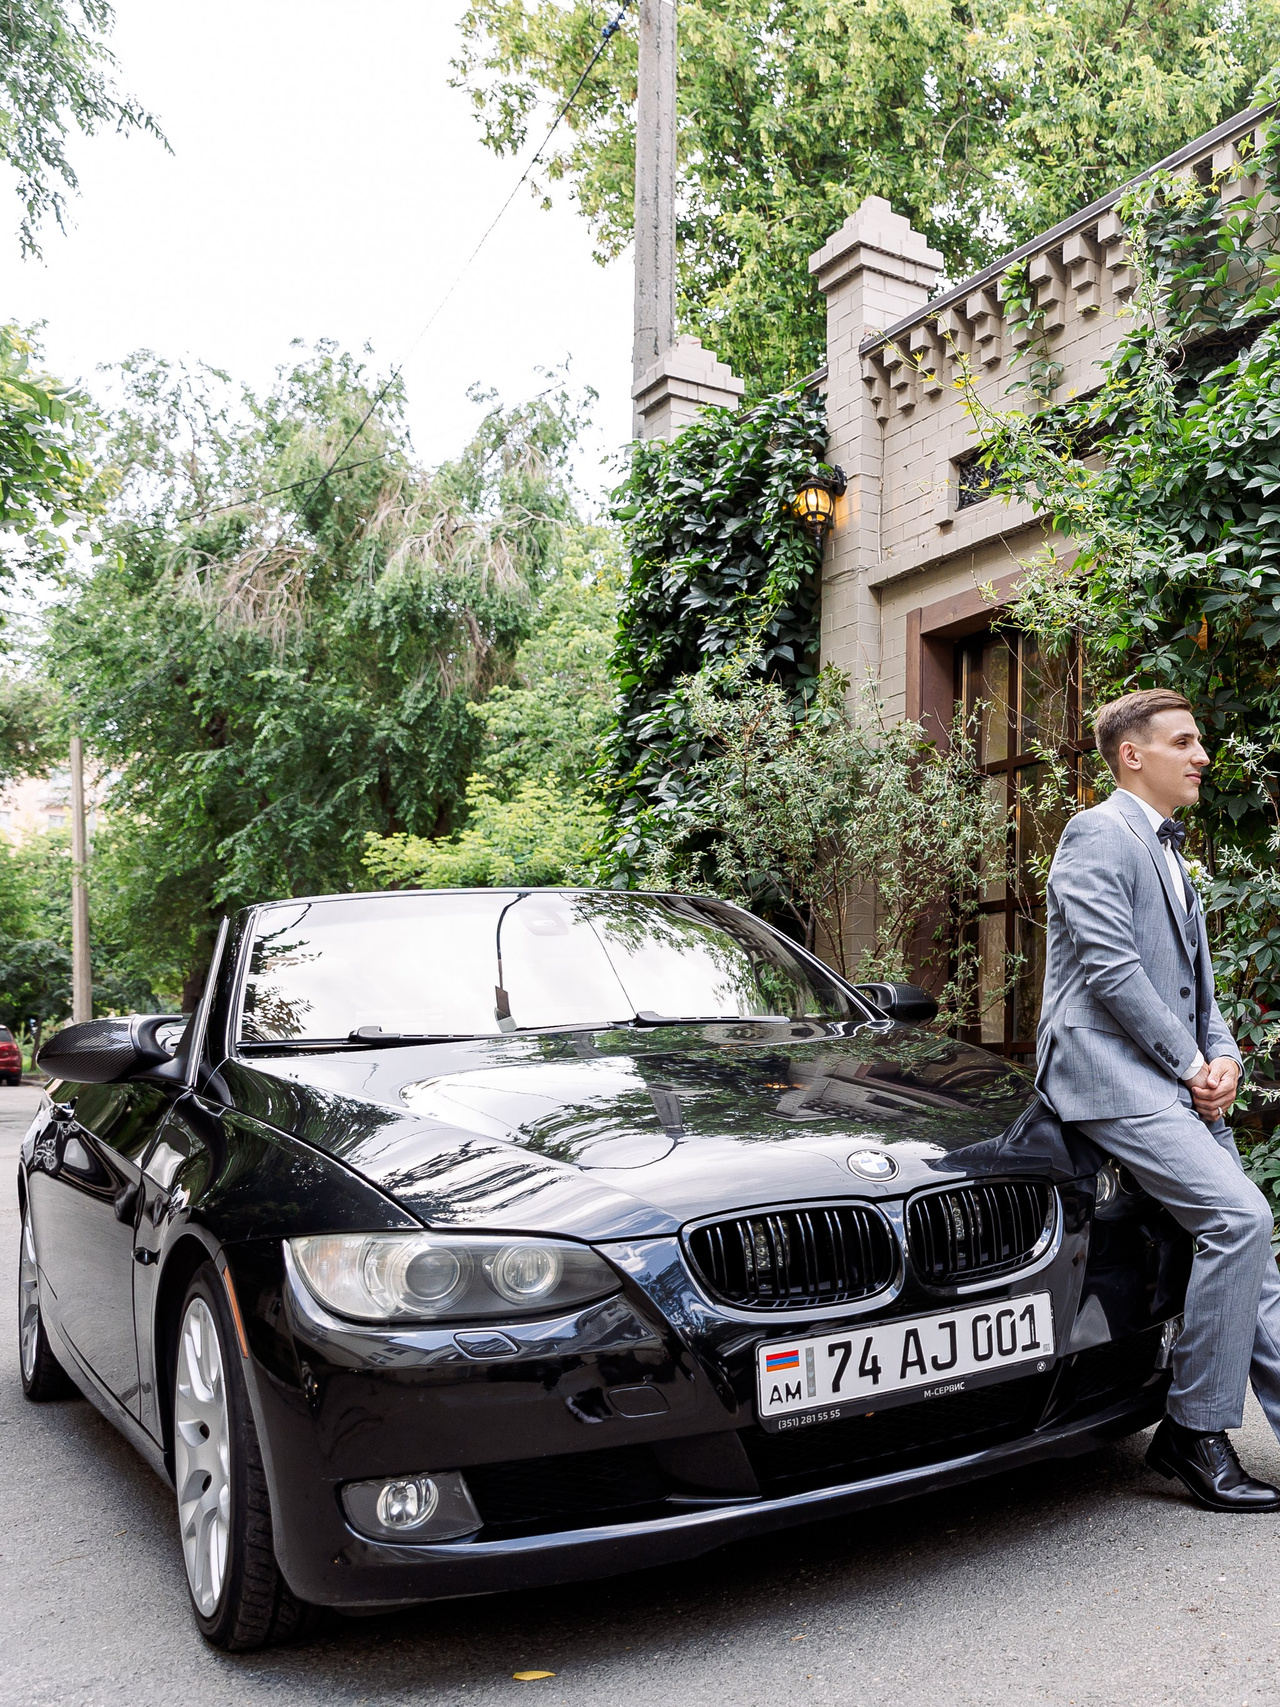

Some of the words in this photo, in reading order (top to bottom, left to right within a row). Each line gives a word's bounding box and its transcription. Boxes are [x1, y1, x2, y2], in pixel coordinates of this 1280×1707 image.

[827, 1336, 882, 1393] 74
[900, 1320, 958, 1380] AJ
[972, 1304, 1041, 1362] 001
[769, 1380, 802, 1405] AM
[923, 1381, 966, 1398] М-СЕРВИС
[778, 1418, 799, 1430] (351)
[801, 1414, 817, 1425] 281
[818, 1411, 829, 1421] 55
[830, 1408, 841, 1418] 55
